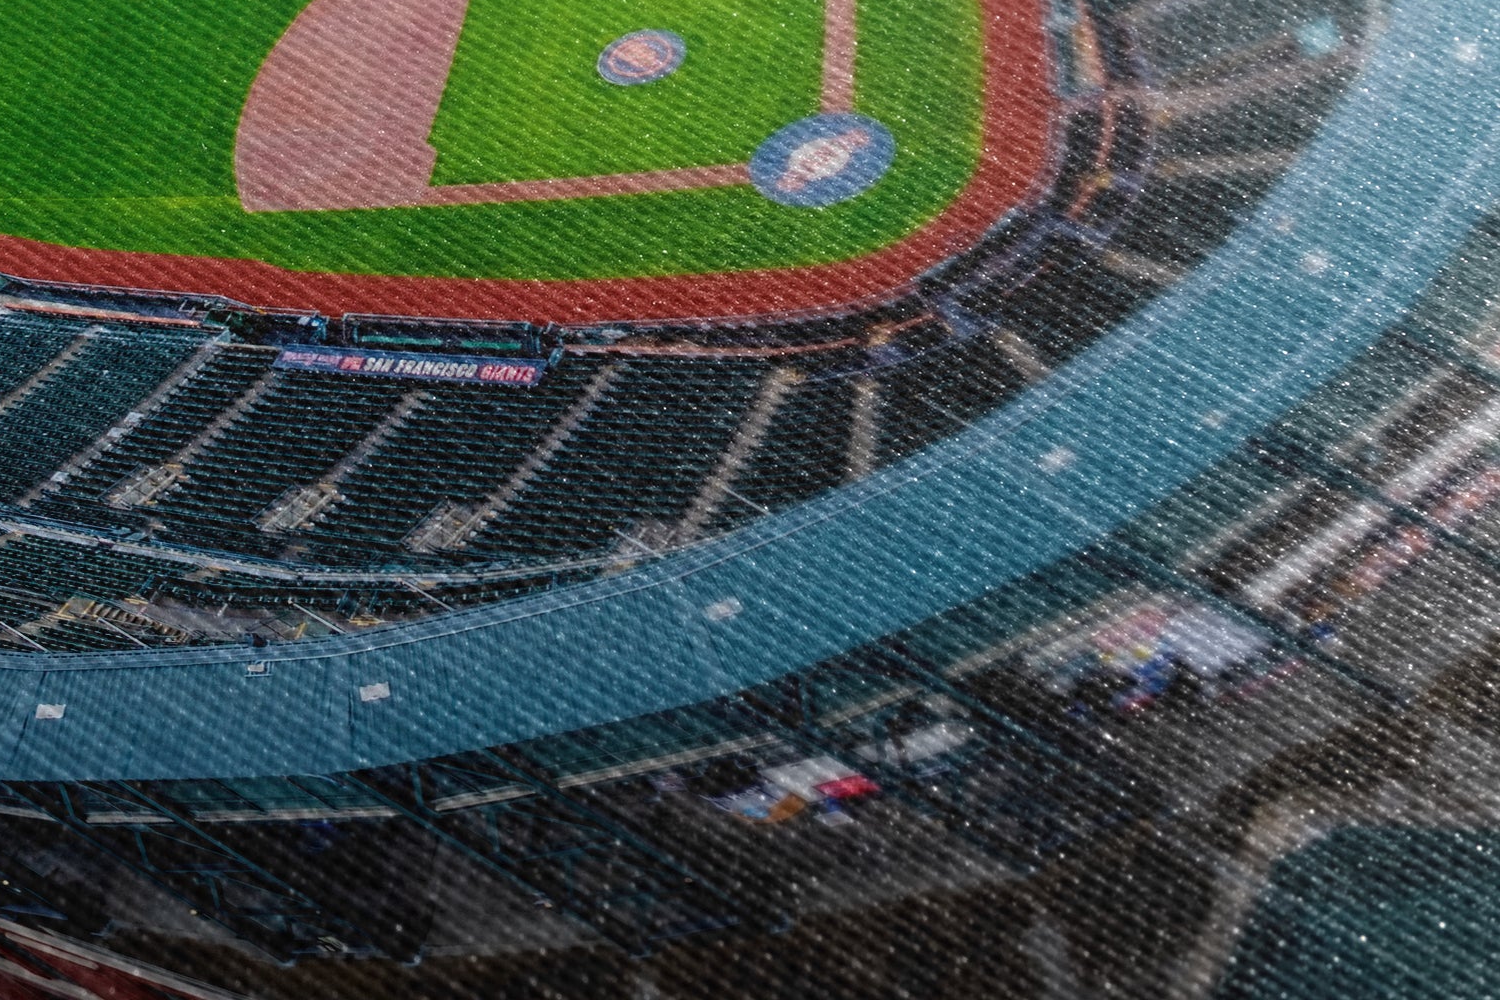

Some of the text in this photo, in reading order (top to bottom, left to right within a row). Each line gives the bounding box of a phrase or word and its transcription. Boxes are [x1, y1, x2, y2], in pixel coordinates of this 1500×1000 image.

[363, 357, 393, 374] SAN
[393, 358, 479, 379] FRANCISCO
[479, 364, 535, 383] GIANTS
